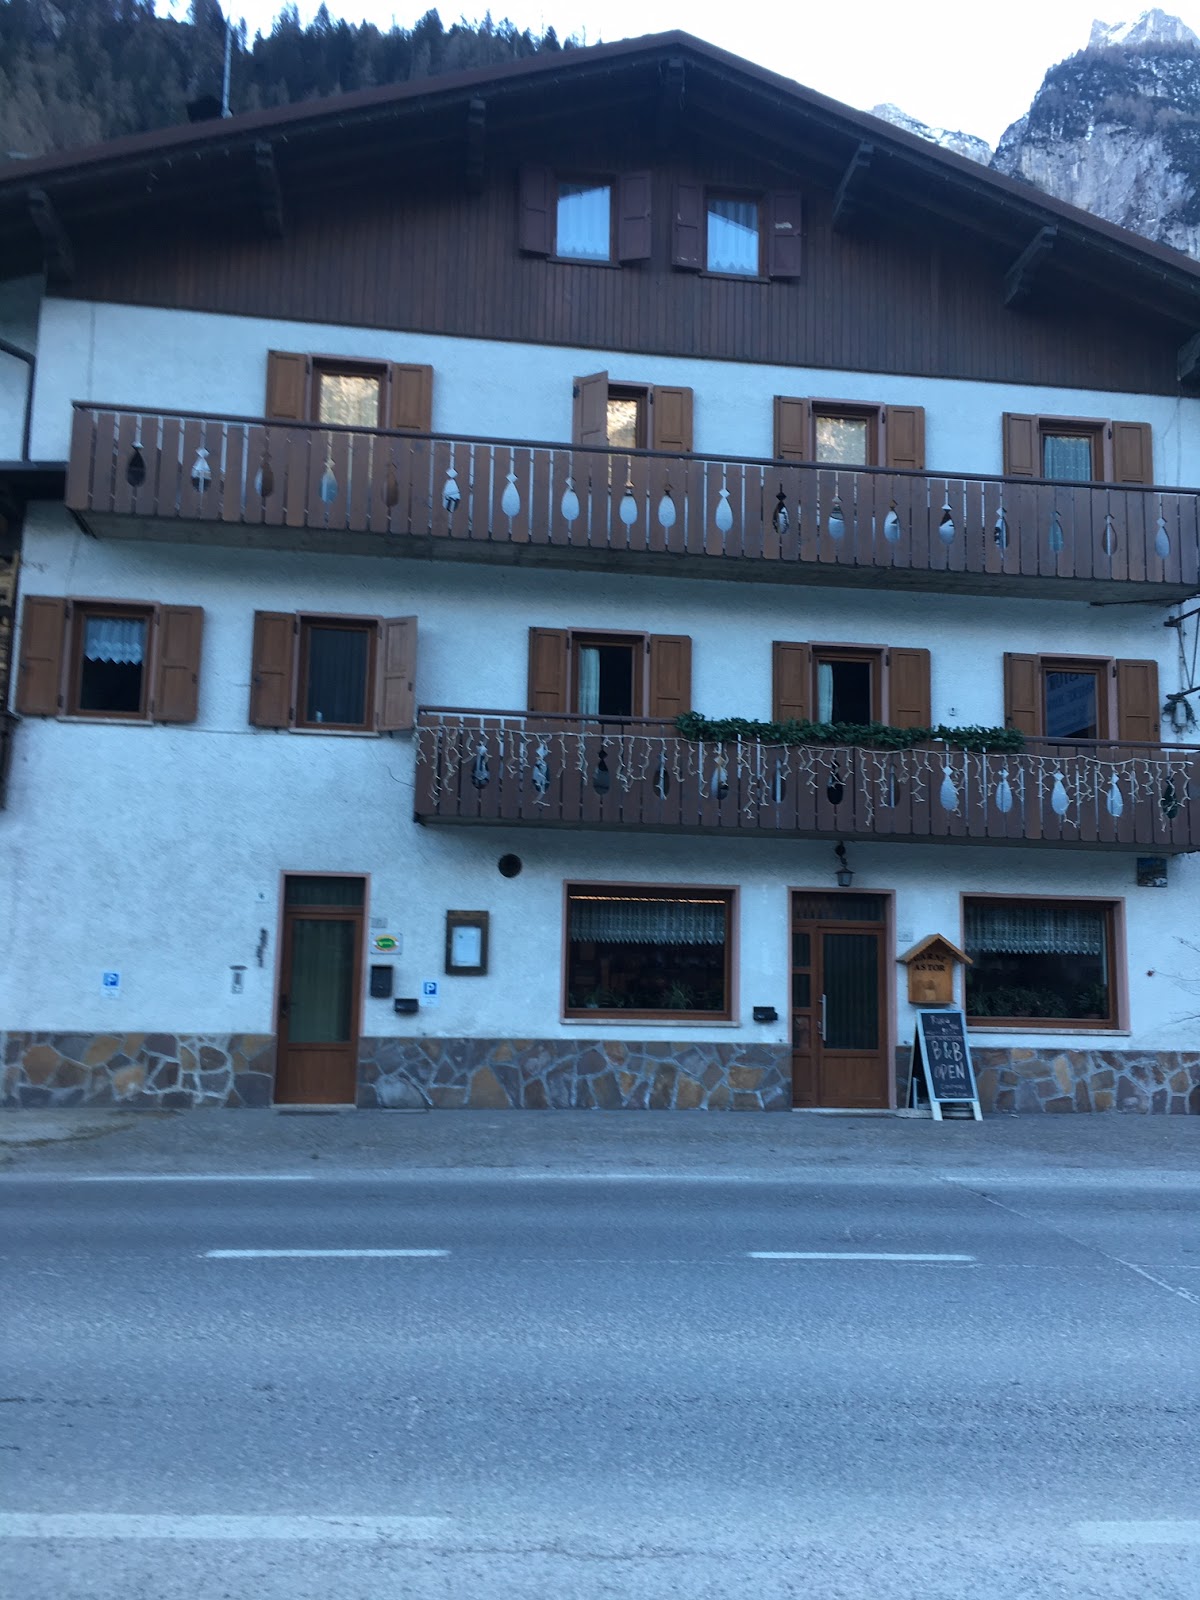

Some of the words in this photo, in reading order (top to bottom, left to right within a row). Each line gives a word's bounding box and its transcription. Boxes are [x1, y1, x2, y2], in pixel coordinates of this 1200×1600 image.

[913, 963, 945, 972] ASTOR
[930, 1040, 963, 1062] B&B
[933, 1062, 966, 1080] OPEN
